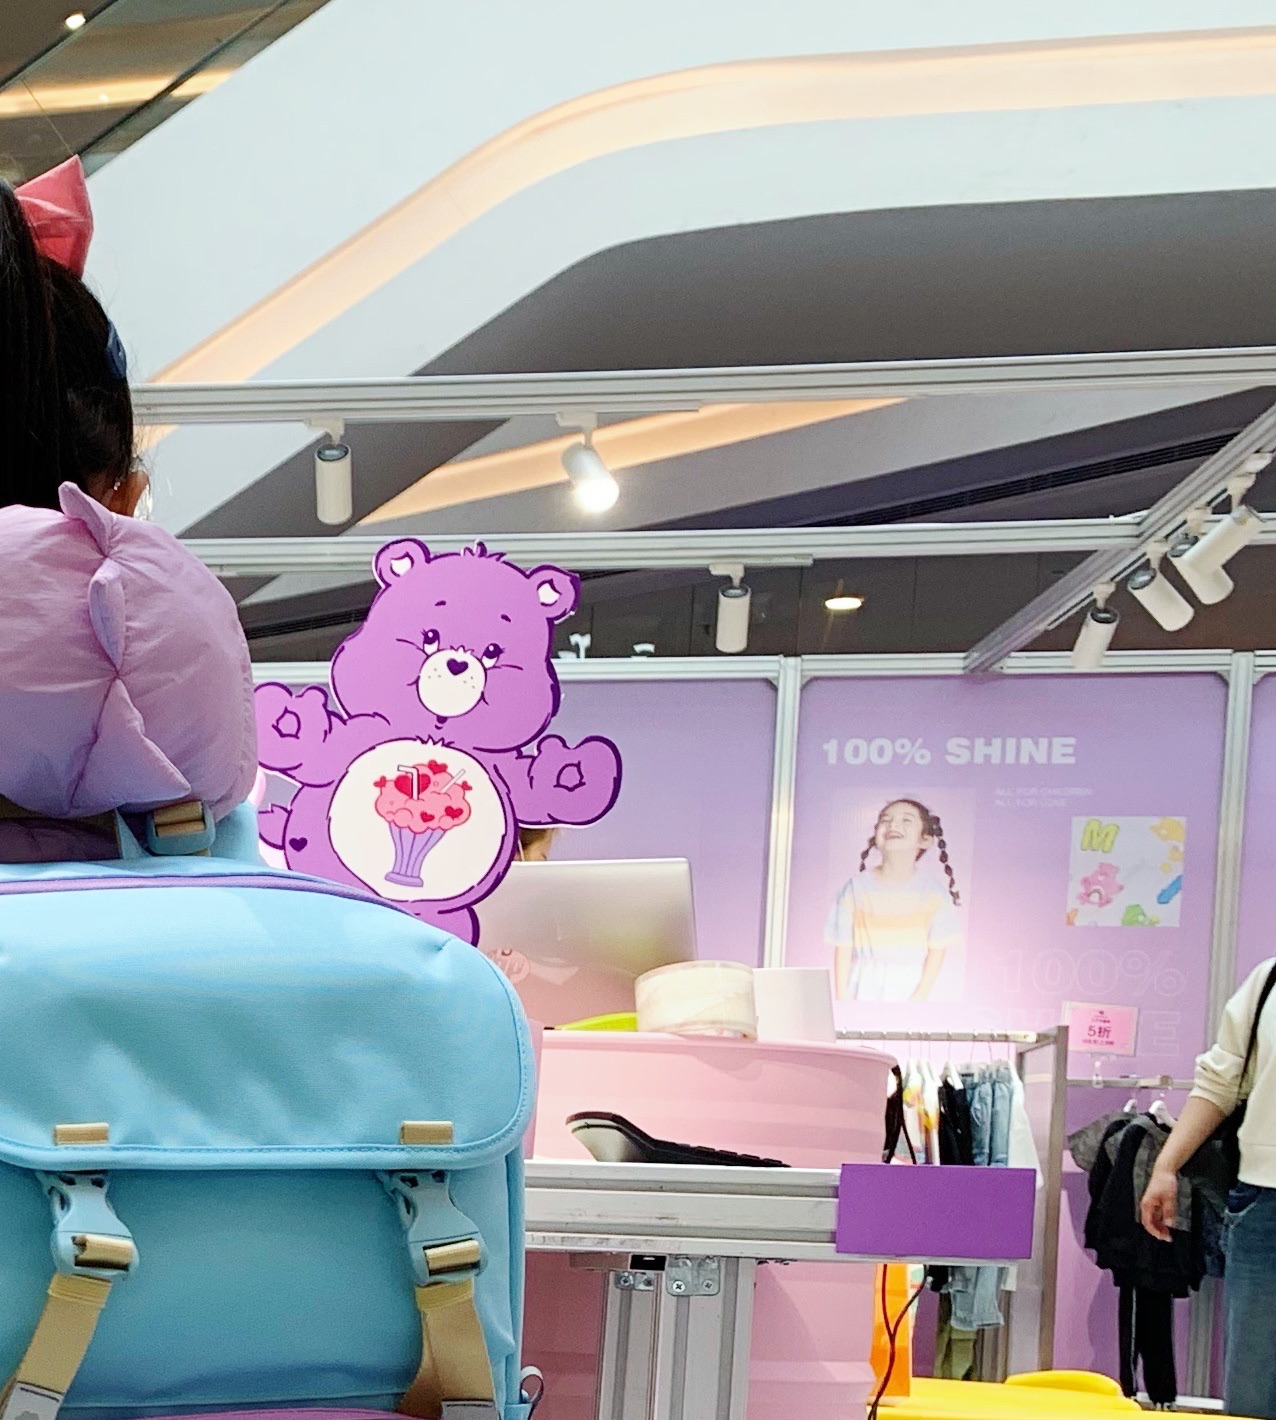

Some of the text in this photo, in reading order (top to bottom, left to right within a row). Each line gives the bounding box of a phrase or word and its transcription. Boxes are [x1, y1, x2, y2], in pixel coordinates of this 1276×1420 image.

[822, 736, 1077, 766] 100% SHINE
[1088, 1025, 1111, 1038] 5折
